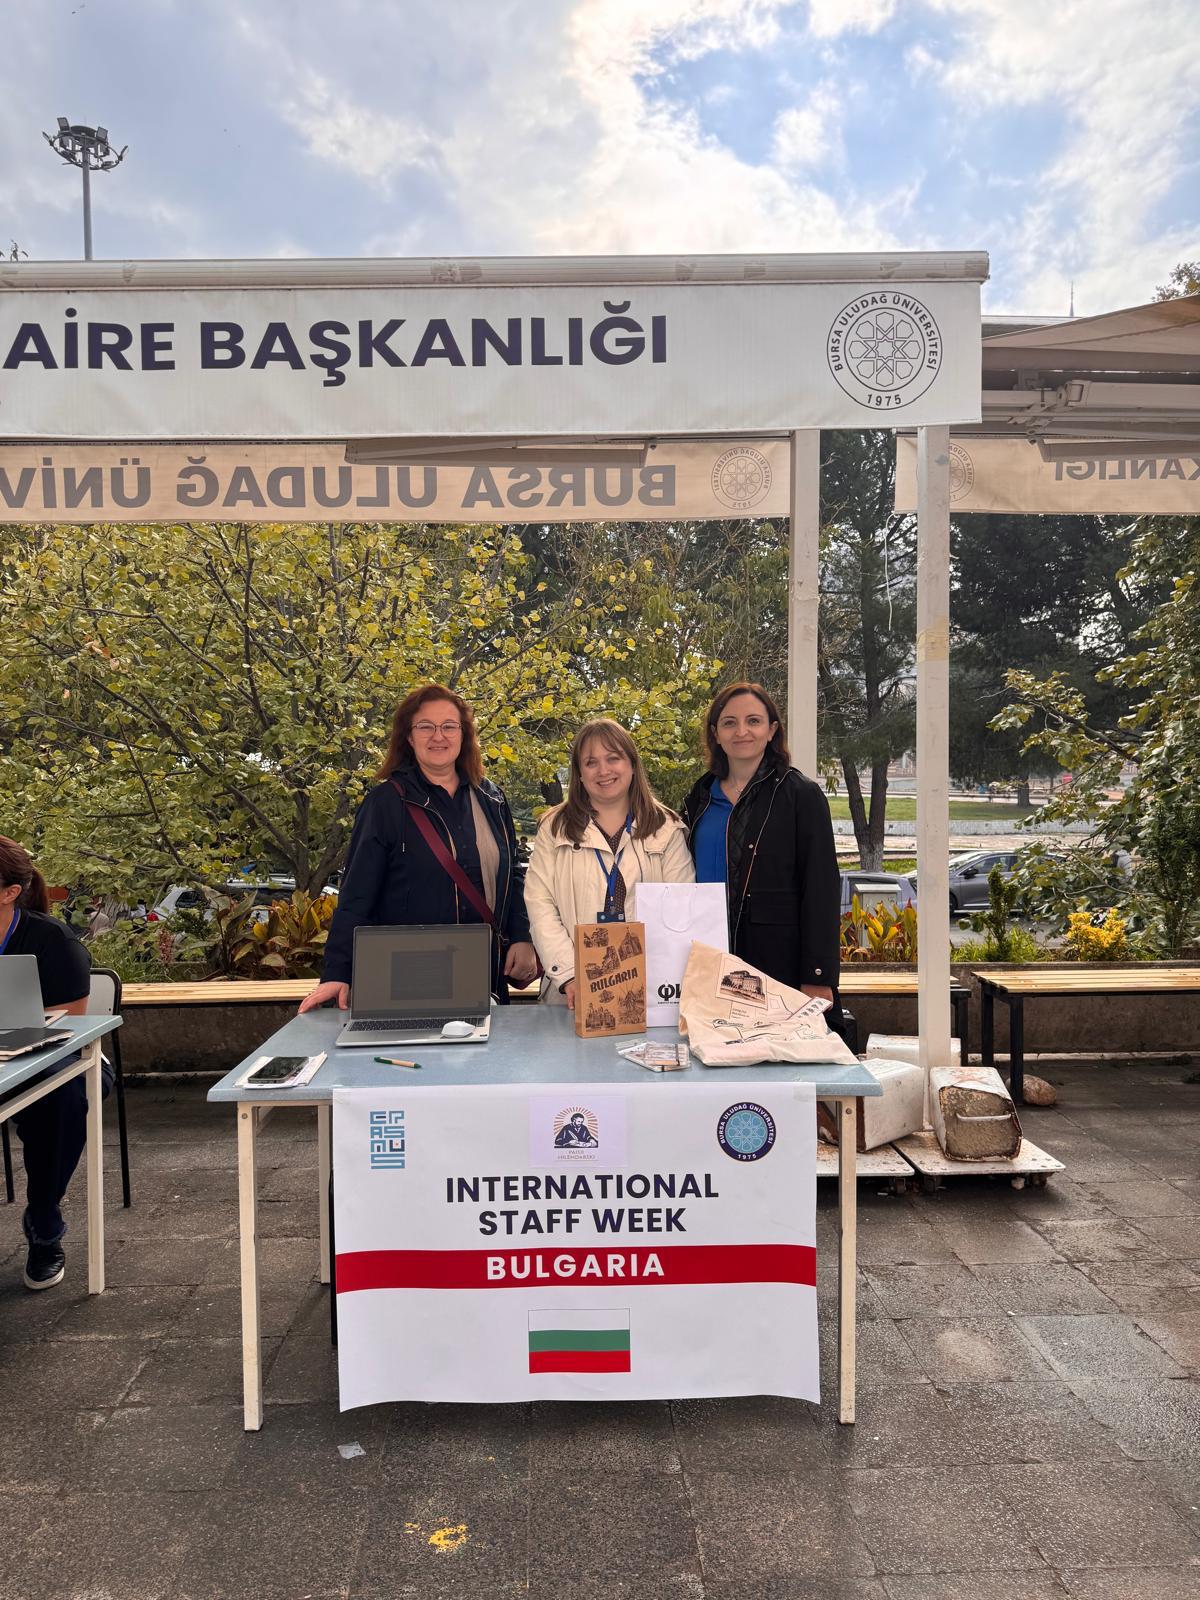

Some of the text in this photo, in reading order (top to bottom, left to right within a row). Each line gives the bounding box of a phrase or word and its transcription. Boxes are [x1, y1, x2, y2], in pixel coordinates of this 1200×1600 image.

[2, 300, 667, 388] AİRE BAŞKANLIĞI
[830, 293, 939, 372] BURSA ULUDAĞ ÜNİVERSİTESİ
[867, 393, 902, 407] 1975
[590, 967, 638, 993] BULGARIA
[718, 1121, 726, 1144] BURSA
[446, 1173, 719, 1203] INTERNATIONAL
[478, 1207, 687, 1236] STAFF WEEK
[486, 1253, 665, 1281] BULGARIA
